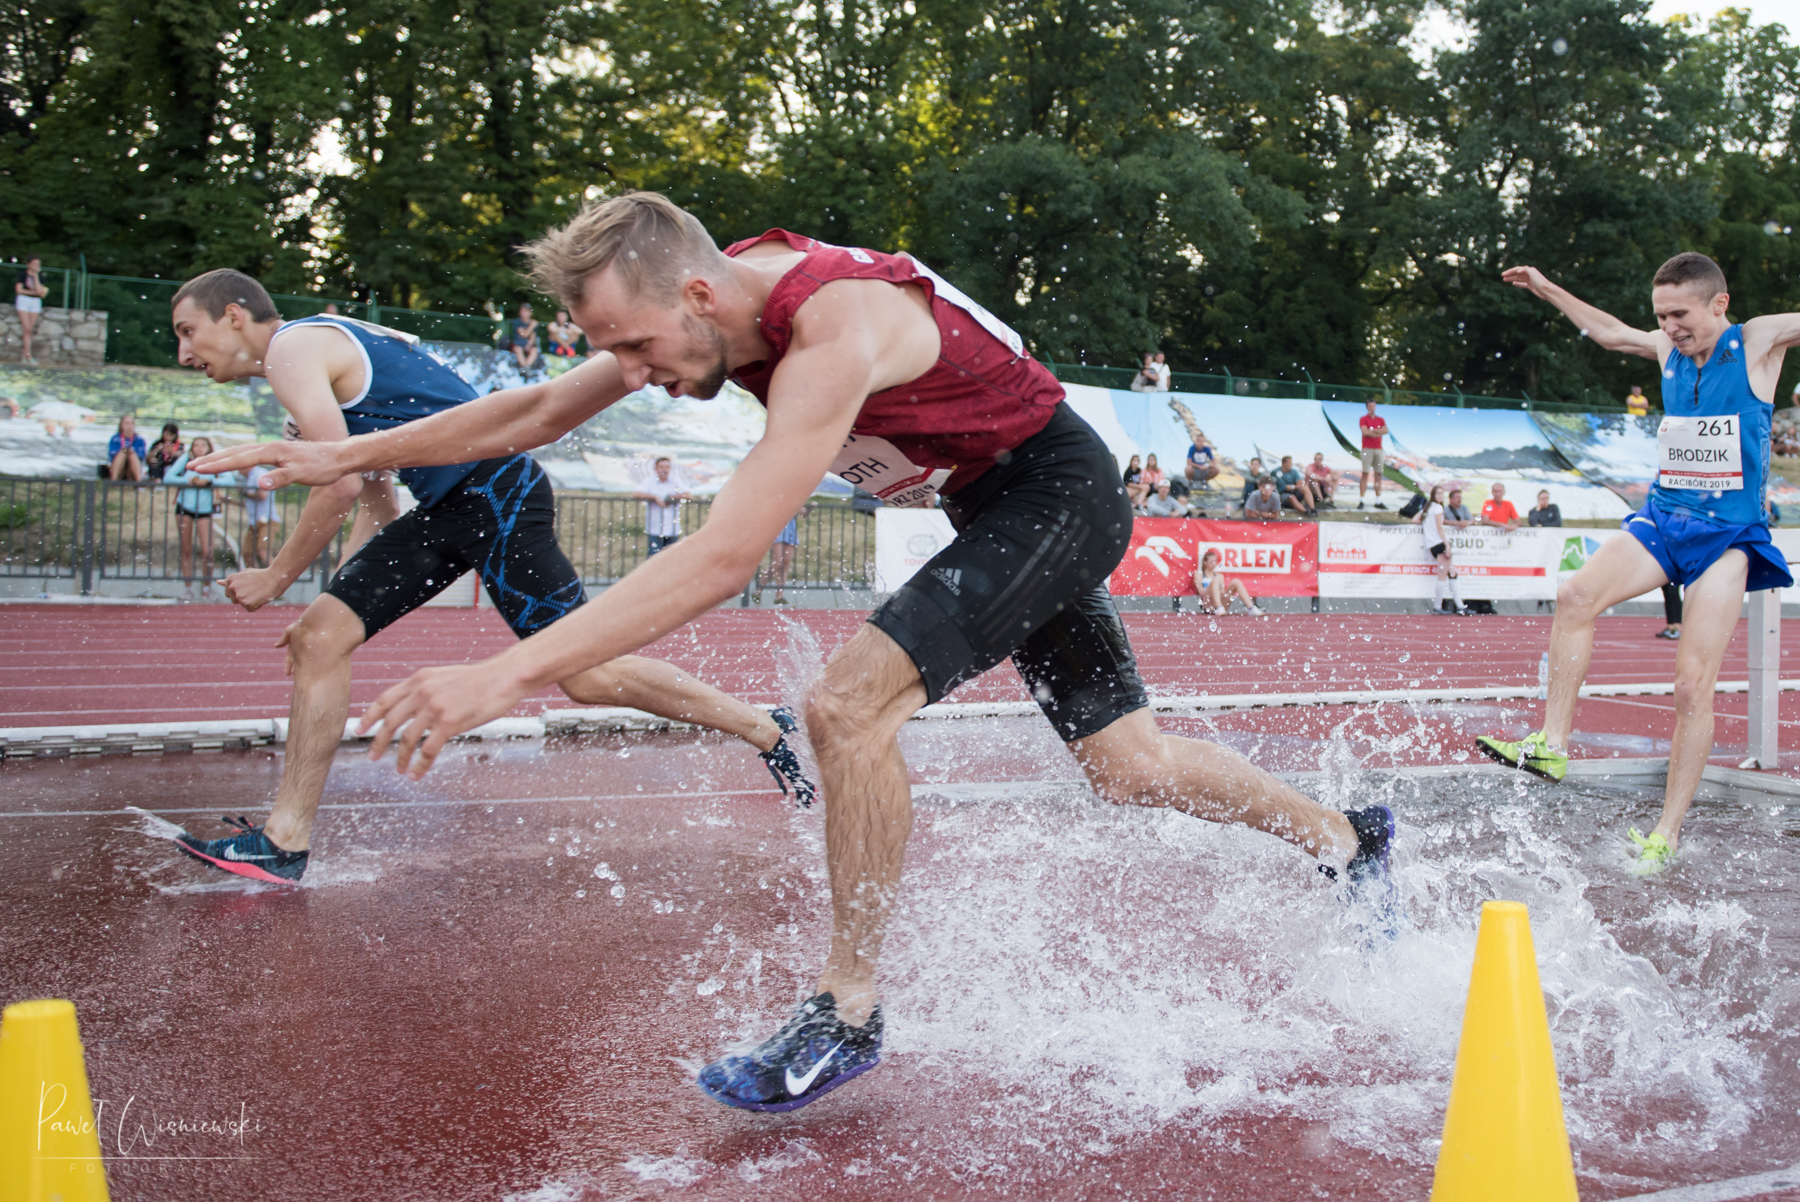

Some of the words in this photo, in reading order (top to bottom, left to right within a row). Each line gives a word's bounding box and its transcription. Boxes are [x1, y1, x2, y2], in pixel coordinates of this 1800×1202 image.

[1697, 419, 1735, 437] 261
[1668, 447, 1729, 462] BRODZIK
[1668, 477, 1708, 488] RACIBÓRZ
[1709, 480, 1731, 488] 2019
[904, 558, 930, 567] TOYO
[930, 568, 961, 596] adidas
